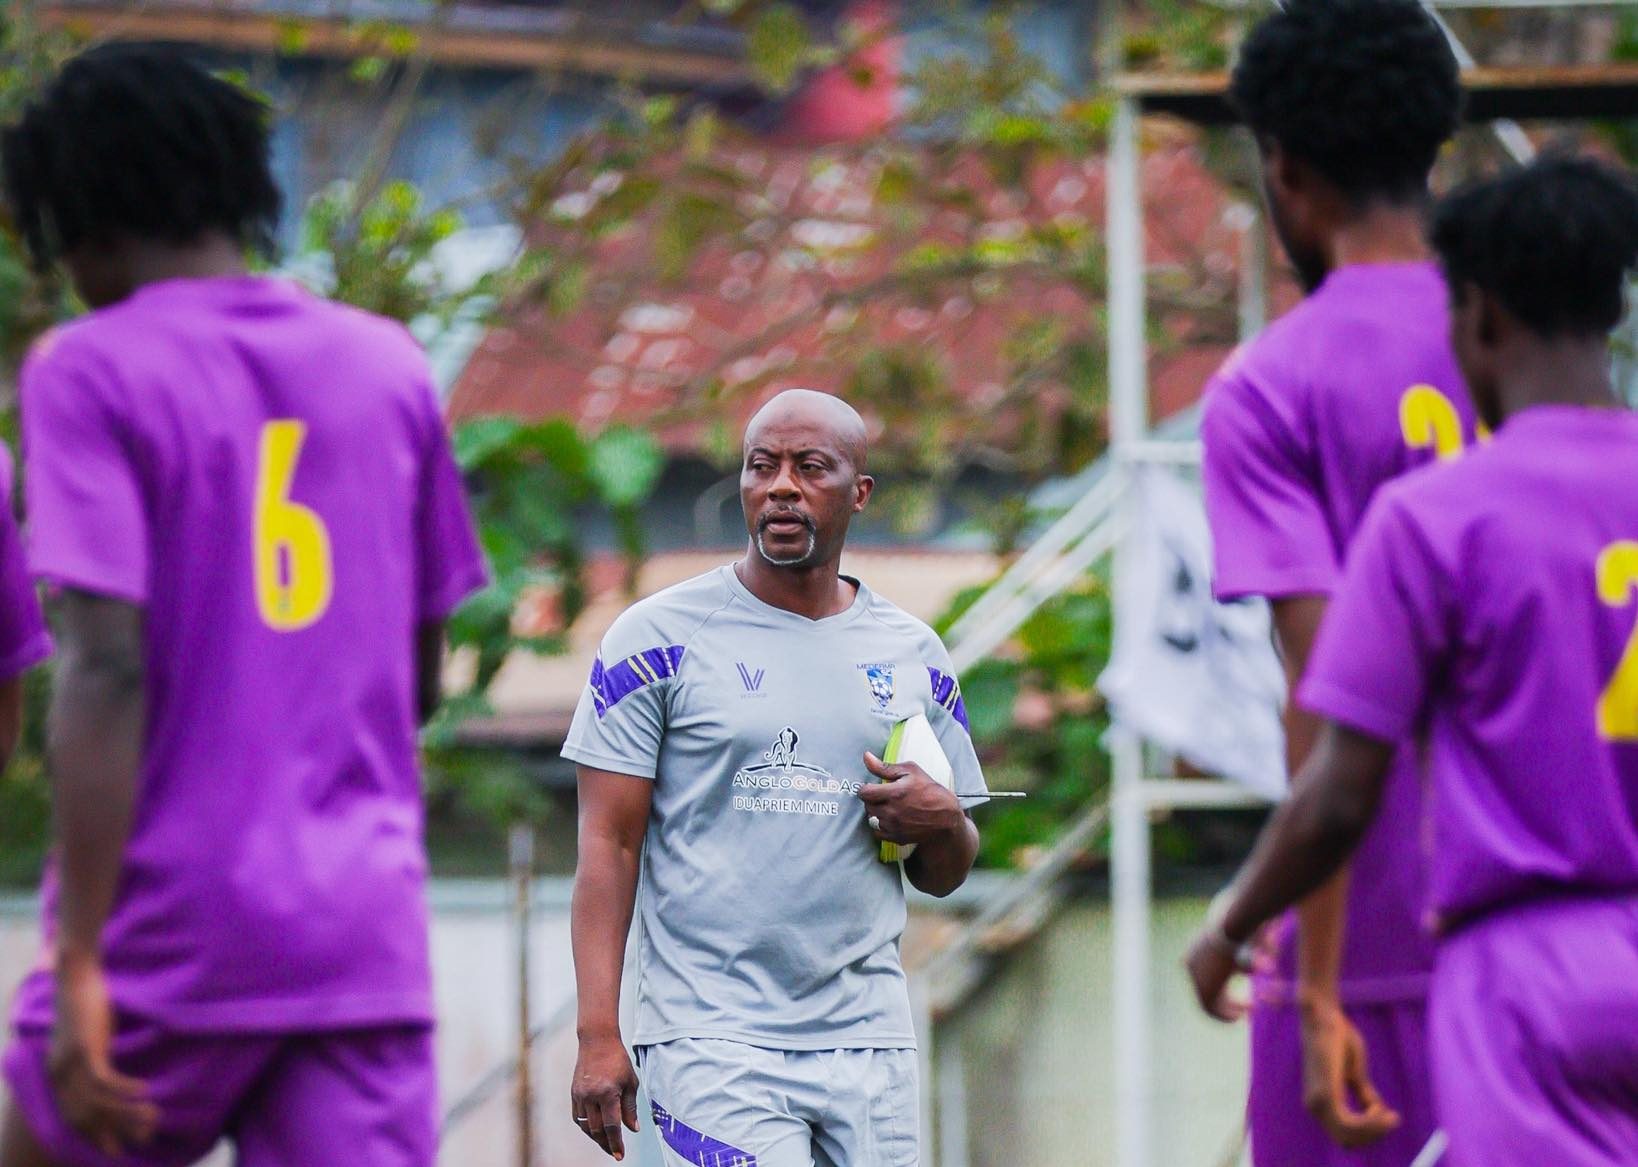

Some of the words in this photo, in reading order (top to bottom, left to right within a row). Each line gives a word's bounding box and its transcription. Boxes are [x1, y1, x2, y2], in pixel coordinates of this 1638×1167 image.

[252, 419, 335, 633] 6
[733, 772, 863, 797] ANGLOGOLDAS
[805, 802, 839, 815] MINE
